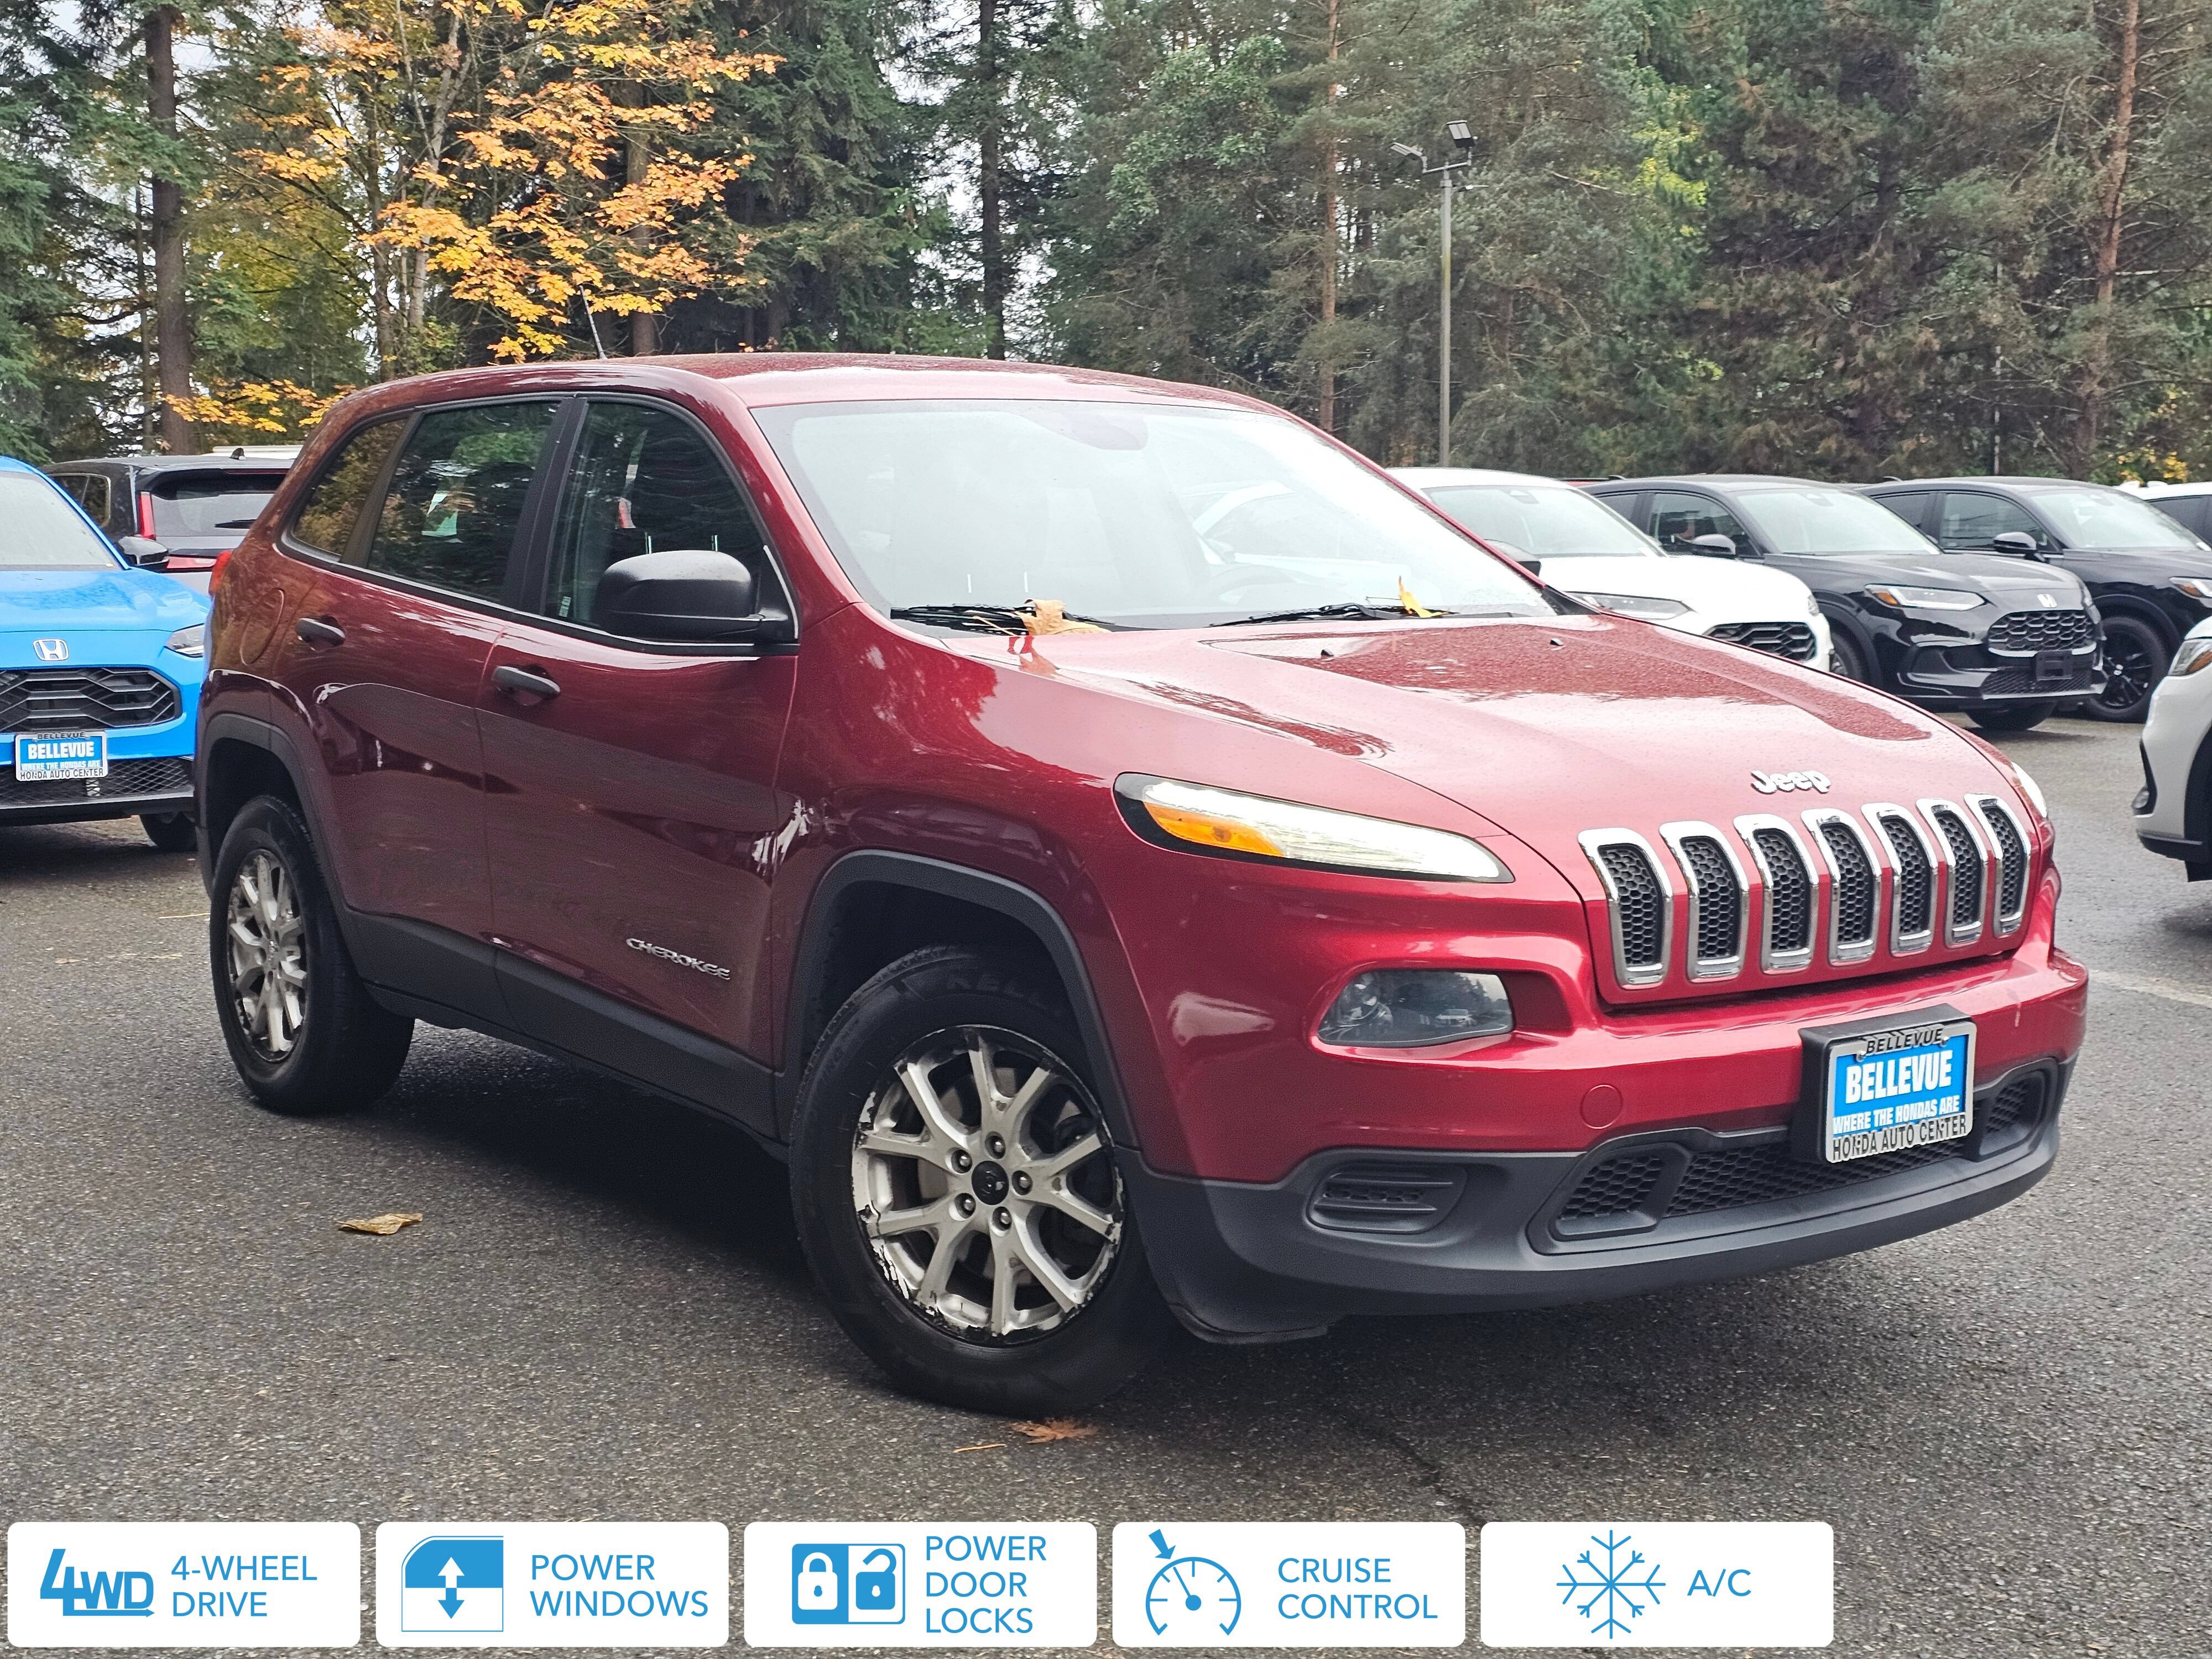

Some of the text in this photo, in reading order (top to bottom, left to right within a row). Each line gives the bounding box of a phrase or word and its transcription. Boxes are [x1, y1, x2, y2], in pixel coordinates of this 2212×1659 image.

[28, 742, 95, 759] BELLEVUE
[20, 768, 103, 780] HONDA AUTO CENTER
[21, 763, 45, 771] WHERE
[60, 761, 86, 769] HONDAS
[1750, 770, 1832, 794] Jeep
[625, 938, 731, 980] CHEROKEE
[1866, 1027, 1944, 1054] BELLEVUE
[1845, 1050, 1953, 1104] BELLEVUE
[1833, 1095, 1960, 1134] WHERE THE HONDAS ARE
[1833, 1115, 1966, 1160] HONDA AUTO CENTER
